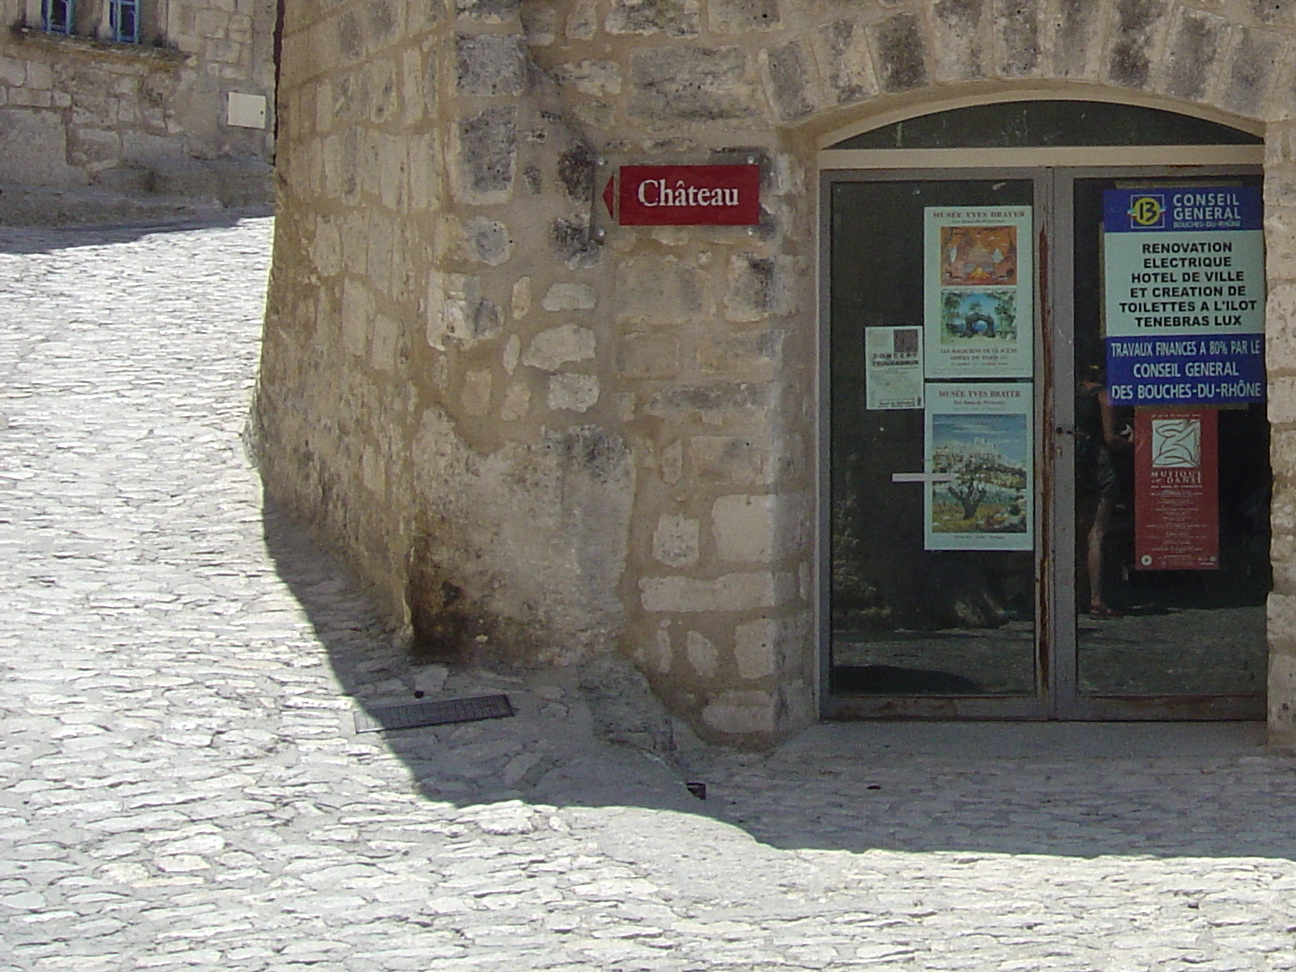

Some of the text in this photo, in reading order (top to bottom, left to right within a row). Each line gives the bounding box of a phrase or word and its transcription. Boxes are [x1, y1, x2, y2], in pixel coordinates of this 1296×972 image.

[637, 179, 740, 207] Château
[1173, 193, 1240, 206] CONSEIL
[1138, 201, 1157, 223] 13
[1173, 207, 1241, 220] GENERAL
[1142, 242, 1232, 254] RENOVATION
[1143, 256, 1232, 269] ELECTRIQUE
[1131, 271, 1244, 283] HOTEL DE VILLE
[1130, 285, 1246, 298] ET CREATION DE
[1119, 300, 1257, 313] TOILETTES A L'ILOT
[1135, 315, 1242, 327] TENEBRAS LUX
[1111, 339, 1260, 357] TRAVAUX FINANCES A 80% PAR LE
[1133, 362, 1239, 378] CONSEIL GENERAL
[968, 389, 988, 398] YVES
[1111, 380, 1262, 399] DES BOUCHES-DU-RHÔNE
